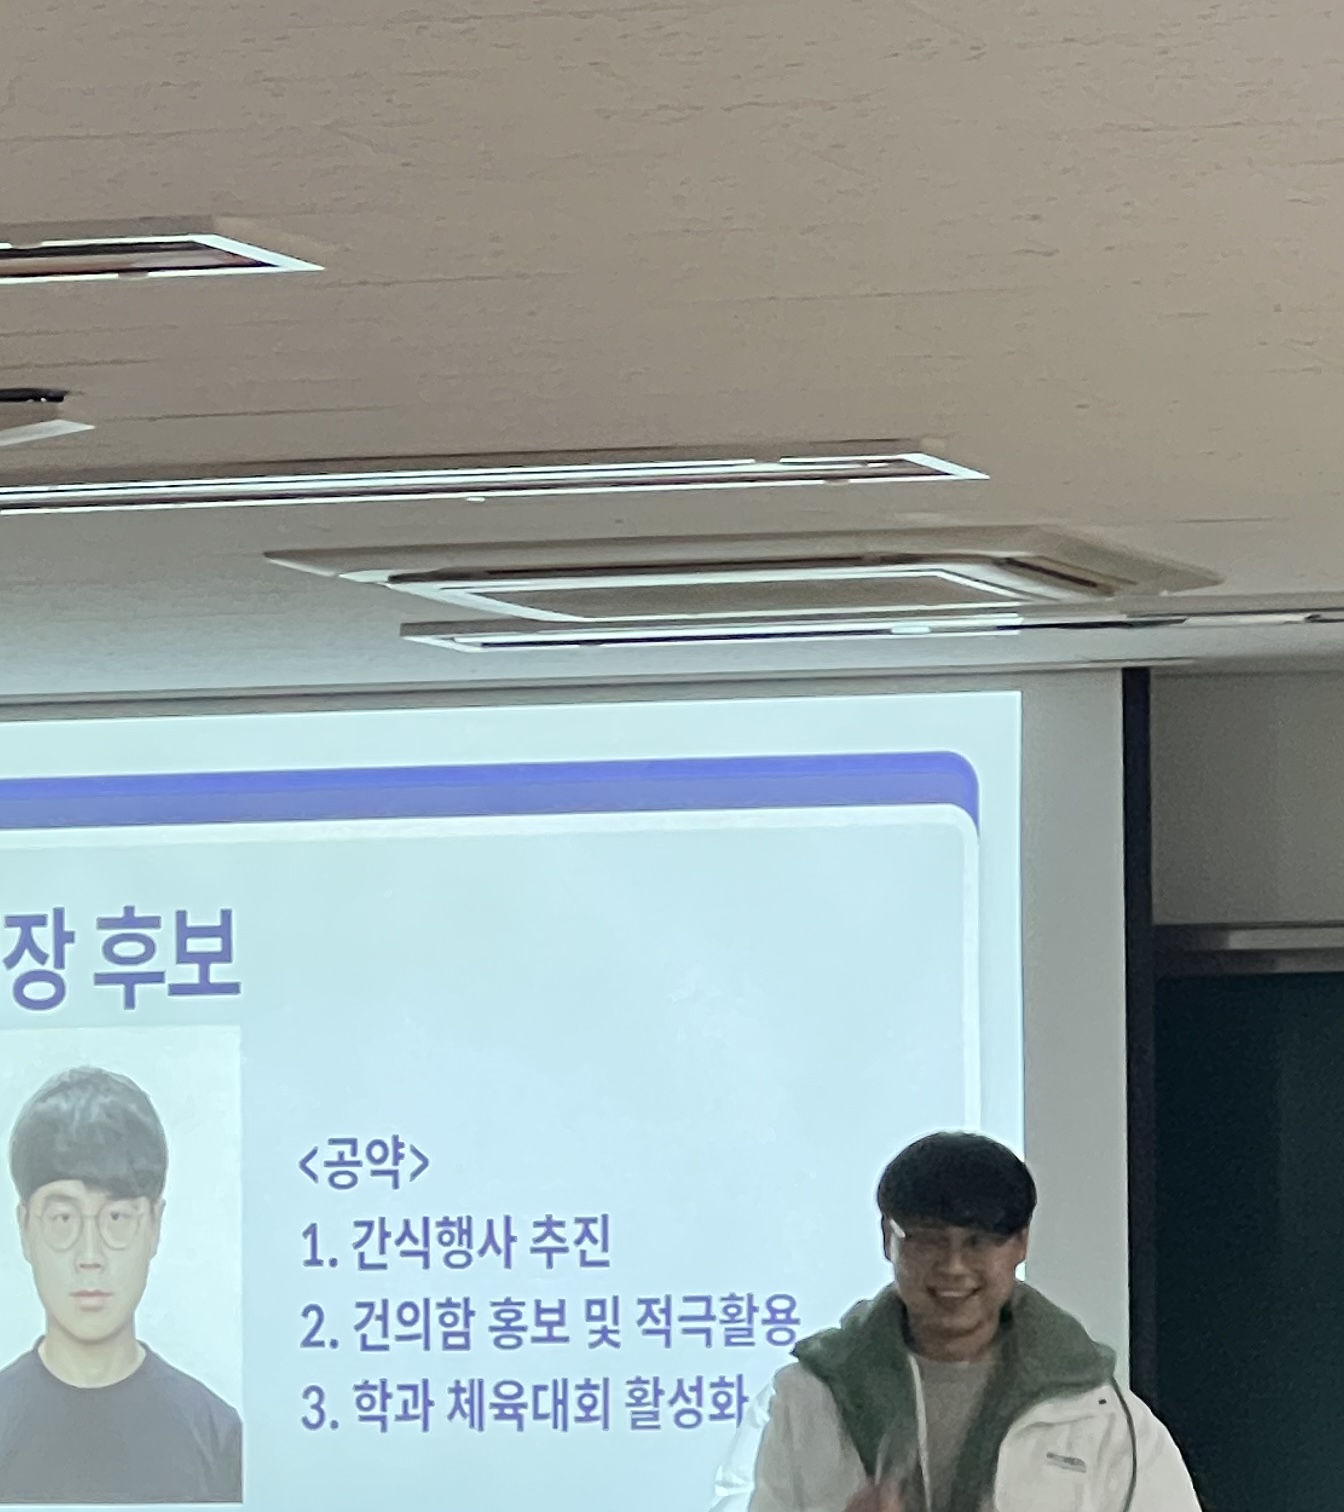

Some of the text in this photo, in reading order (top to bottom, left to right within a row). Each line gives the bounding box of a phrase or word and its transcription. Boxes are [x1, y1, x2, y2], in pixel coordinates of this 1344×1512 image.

[93, 904, 242, 1012] 후보
[298, 1133, 430, 1190] <공약>
[301, 1213, 612, 1272] 1. 간식행사 추진
[299, 1291, 801, 1353] 2. 건의함 홍보 및 적극활용
[300, 1373, 750, 1433] 3. 학과 체육대회 활성화
